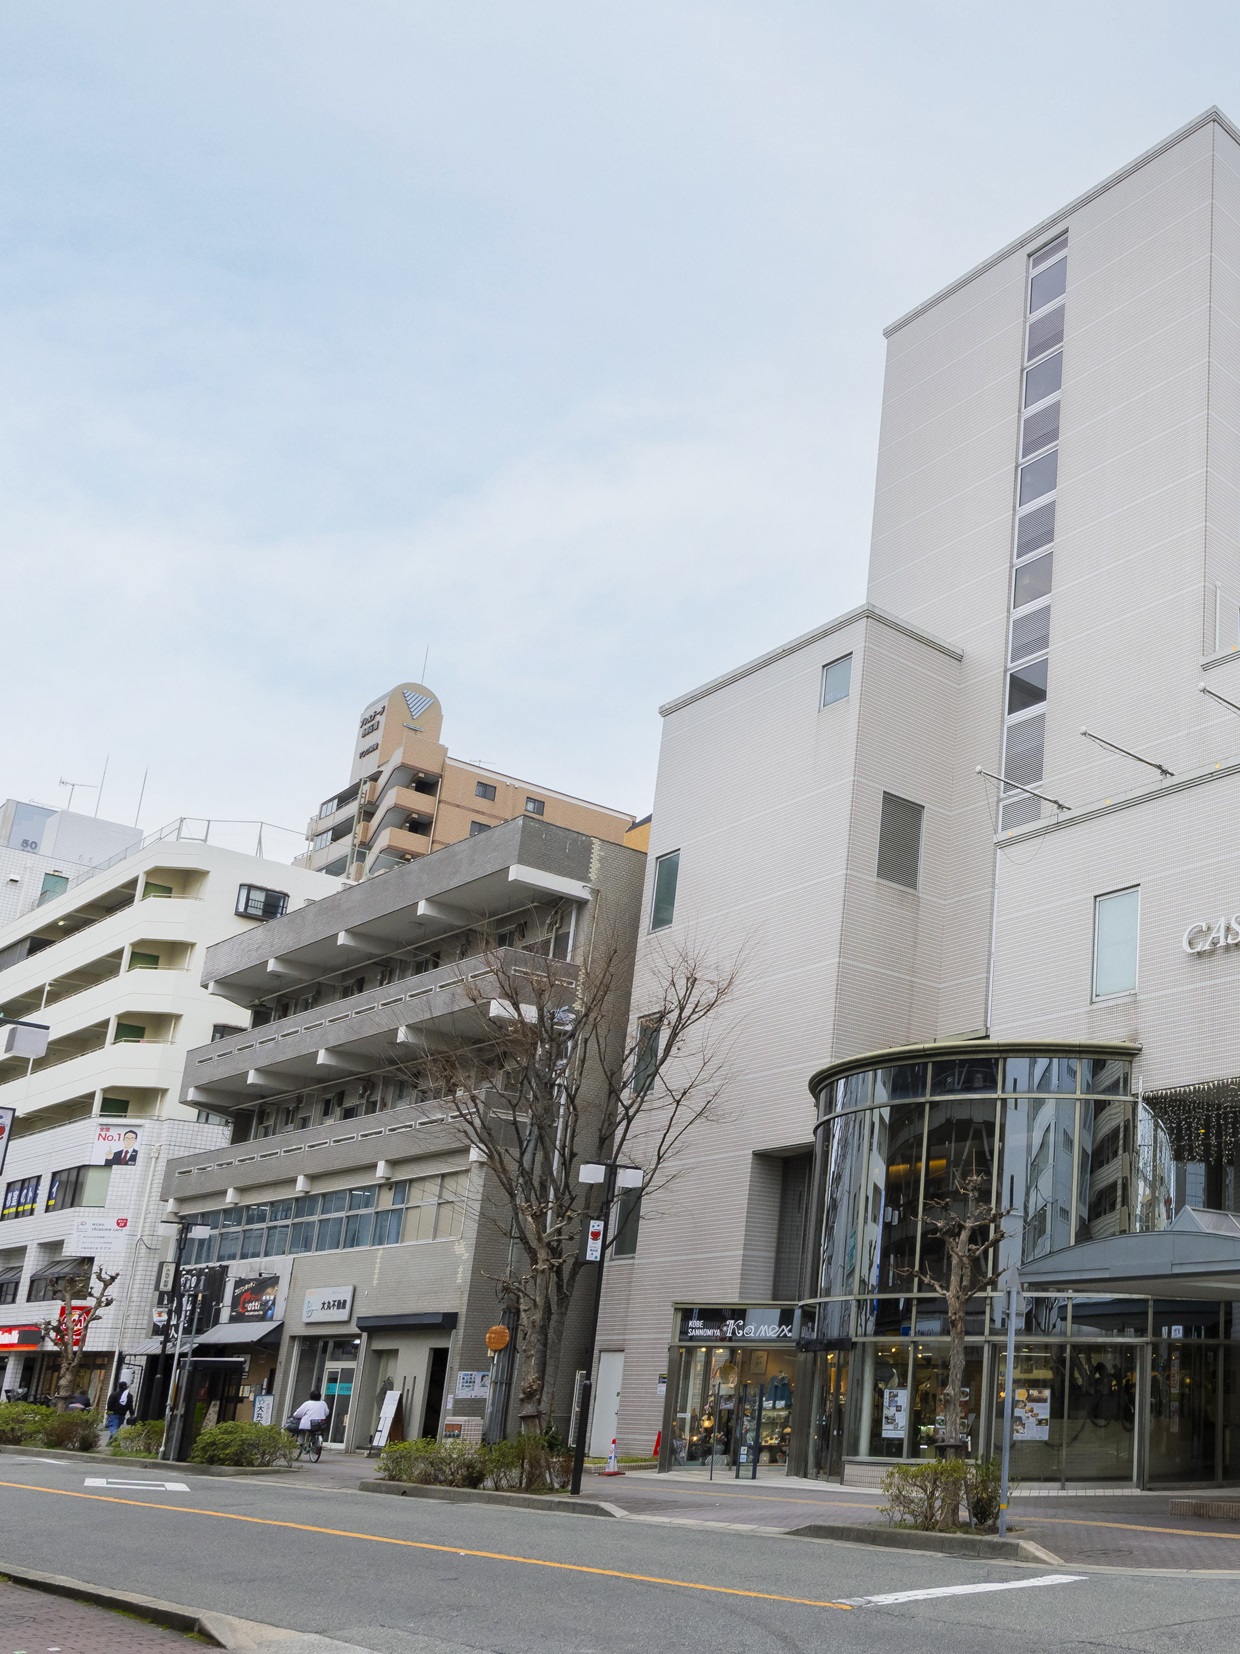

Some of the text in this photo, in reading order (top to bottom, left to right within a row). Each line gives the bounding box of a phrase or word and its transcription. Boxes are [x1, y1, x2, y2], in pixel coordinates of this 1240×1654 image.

[20, 838, 38, 850] 50
[97, 1132, 122, 1142] No.1
[688, 1320, 704, 1328] KOBE
[688, 1328, 720, 1336] SANNOMIYA
